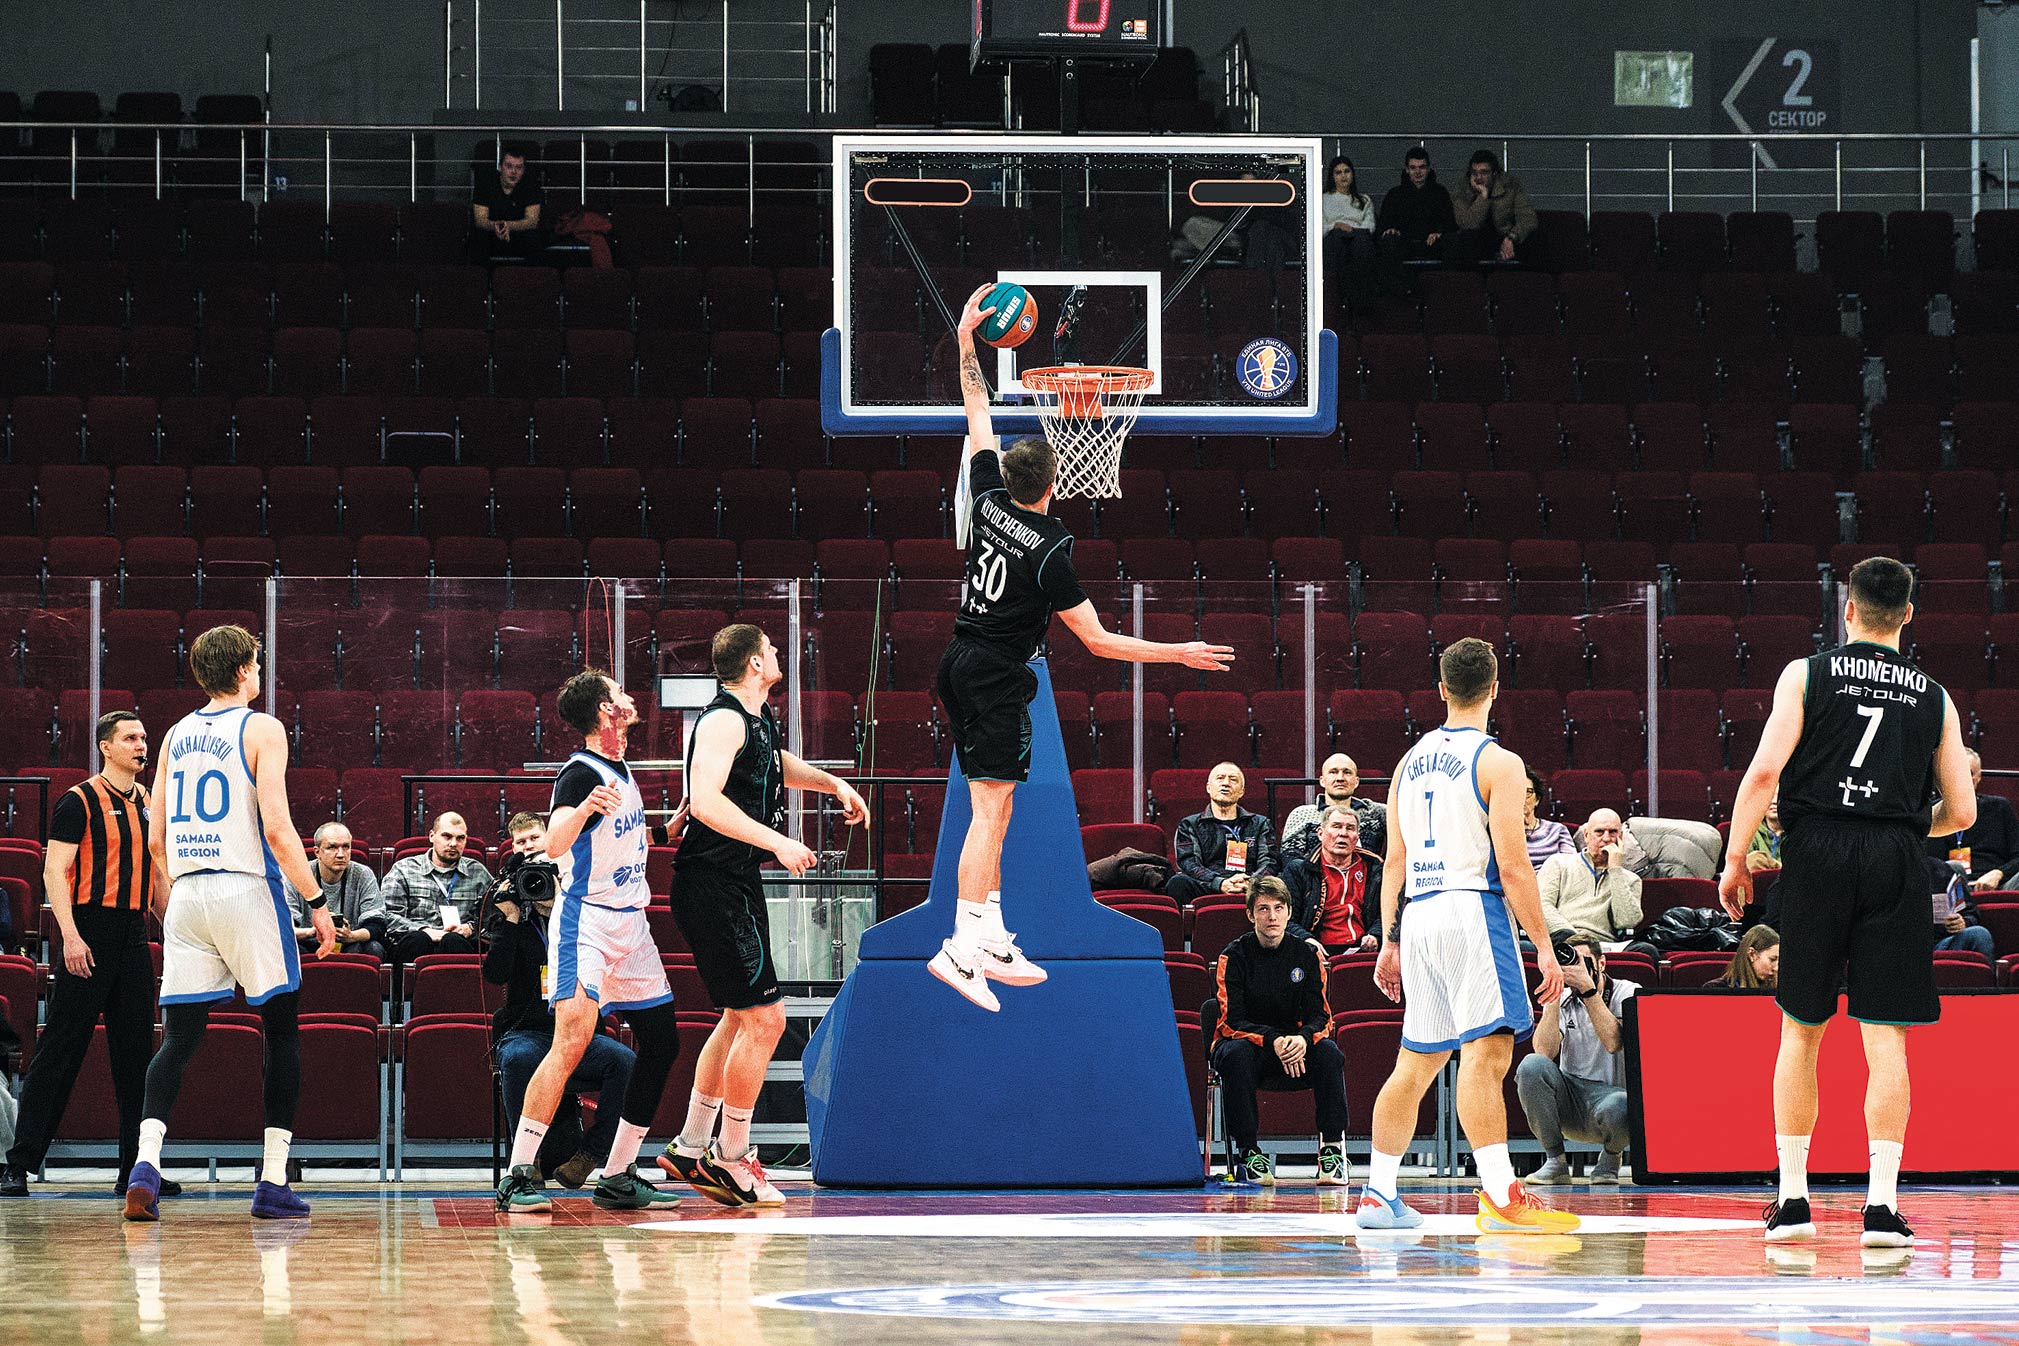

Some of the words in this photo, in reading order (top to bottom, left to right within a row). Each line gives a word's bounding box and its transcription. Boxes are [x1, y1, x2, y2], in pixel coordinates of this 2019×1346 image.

[1783, 49, 1812, 106] 2
[1768, 111, 1827, 127] СЕКТОР
[996, 295, 1022, 330] SIBUR
[1241, 340, 1265, 359] ЕДИНАЯ
[980, 524, 1025, 560] JETOUR
[971, 539, 1008, 602] 30
[1830, 655, 1928, 693] KHOMENKO
[1835, 683, 1918, 708] JETOUR
[1849, 703, 1885, 769] 7
[170, 769, 230, 824] 10
[175, 833, 222, 844] SAMARA
[177, 848, 221, 858] REGION
